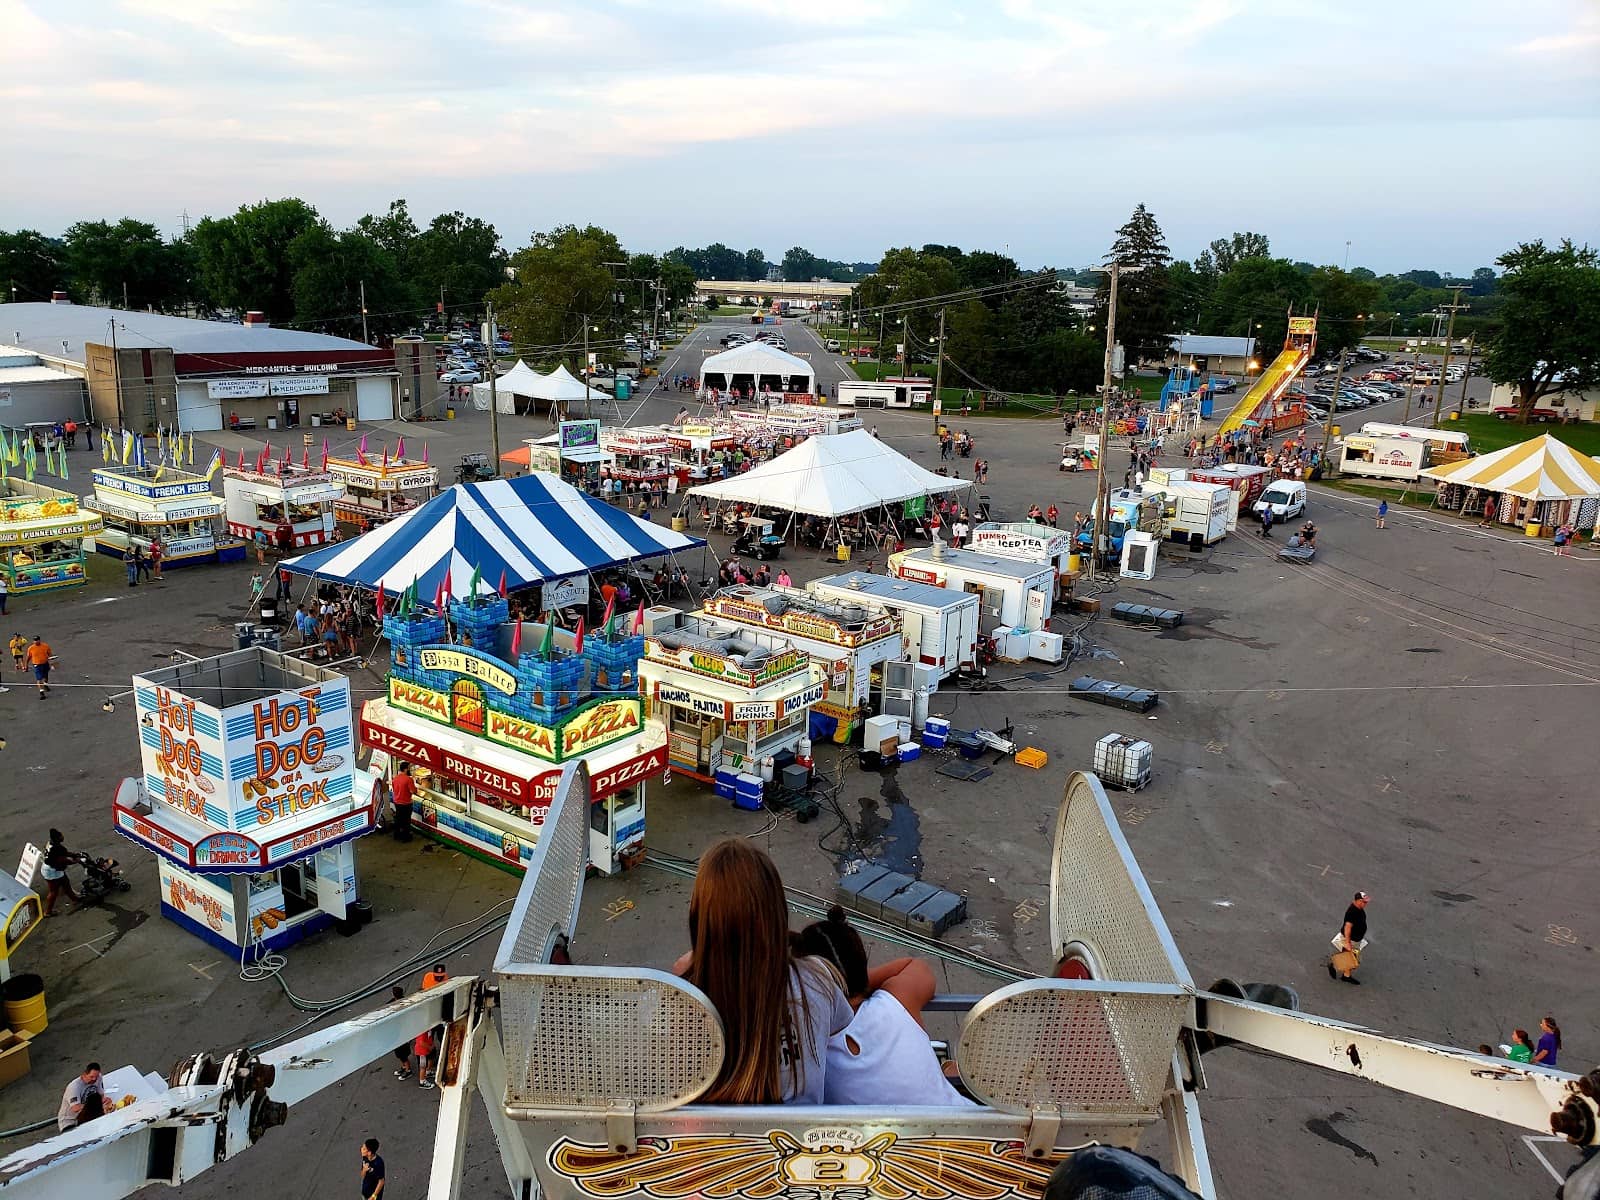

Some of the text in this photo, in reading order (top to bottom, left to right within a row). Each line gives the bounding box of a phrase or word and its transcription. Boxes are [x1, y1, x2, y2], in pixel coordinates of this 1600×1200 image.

[245, 363, 338, 374] MERCANTILE BUILDING
[1390, 459, 1413, 468] CREAM
[349, 475, 373, 486] GYROS
[403, 475, 431, 488] GYROS
[155, 484, 185, 497] FRENCH
[187, 481, 210, 495] FRIES
[171, 507, 195, 519] FRENCH
[197, 505, 216, 516] FRIES
[22, 525, 83, 539] FUNNEL CAKES
[976, 533, 1007, 542] JUMBO
[170, 540, 215, 555] FRENCH FRIES
[998, 539, 1042, 548] ICED TEA
[423, 651, 513, 690] Pizza Palace
[694, 654, 725, 673] TACOS
[766, 652, 797, 677] FAJITAS
[392, 680, 448, 719] PIZZA
[660, 689, 691, 703] NACHOS
[784, 686, 823, 712] TACO SALAD
[693, 700, 724, 715] FAJITAS
[739, 705, 769, 713] FRUIT
[735, 711, 775, 720] DRINKS
[490, 712, 553, 754] PIZZA
[564, 708, 639, 753] PIZZA
[367, 727, 431, 762] PIZZA
[281, 771, 303, 785] ON A
[445, 755, 522, 797] PRETZELS
[594, 754, 661, 793] PIZZA
[534, 785, 557, 799] DRI
[209, 850, 249, 863] DRINKS
[813, 1158, 846, 1180] 2
